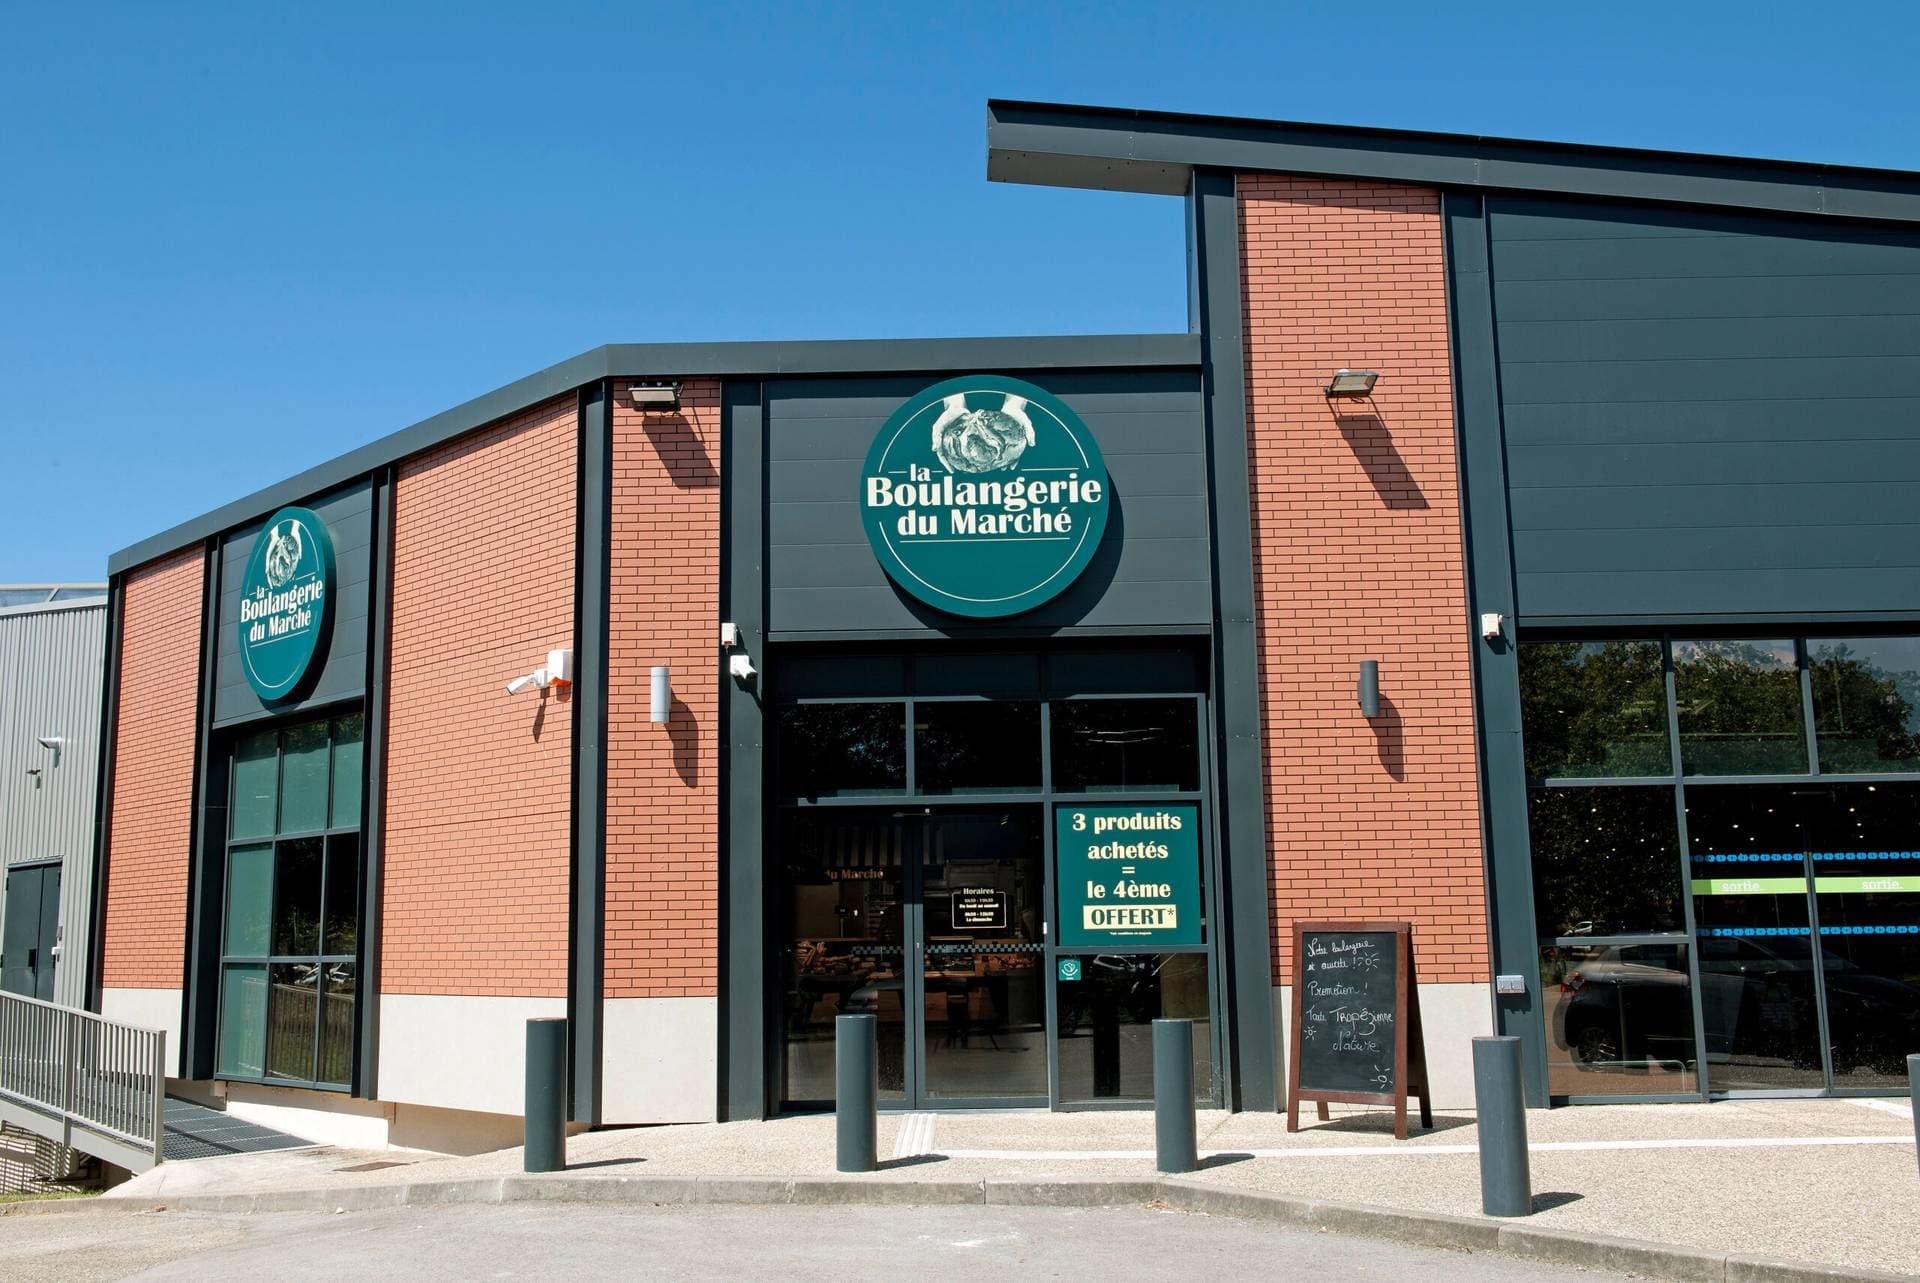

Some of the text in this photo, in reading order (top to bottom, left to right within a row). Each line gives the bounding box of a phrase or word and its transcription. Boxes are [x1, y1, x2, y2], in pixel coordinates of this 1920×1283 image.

[909, 463, 931, 481] la
[866, 473, 1102, 512] Boulangerie
[897, 507, 1072, 535] du Marché
[240, 575, 323, 623] Boulangerie
[256, 585, 265, 600] la
[249, 604, 311, 642] du Marché
[1072, 812, 1182, 834] 3 produits
[1087, 841, 1169, 859] achetés
[963, 887, 995, 895] Horaires
[1086, 880, 1171, 898] le 4ème
[1307, 980, 1359, 996] Promotion
